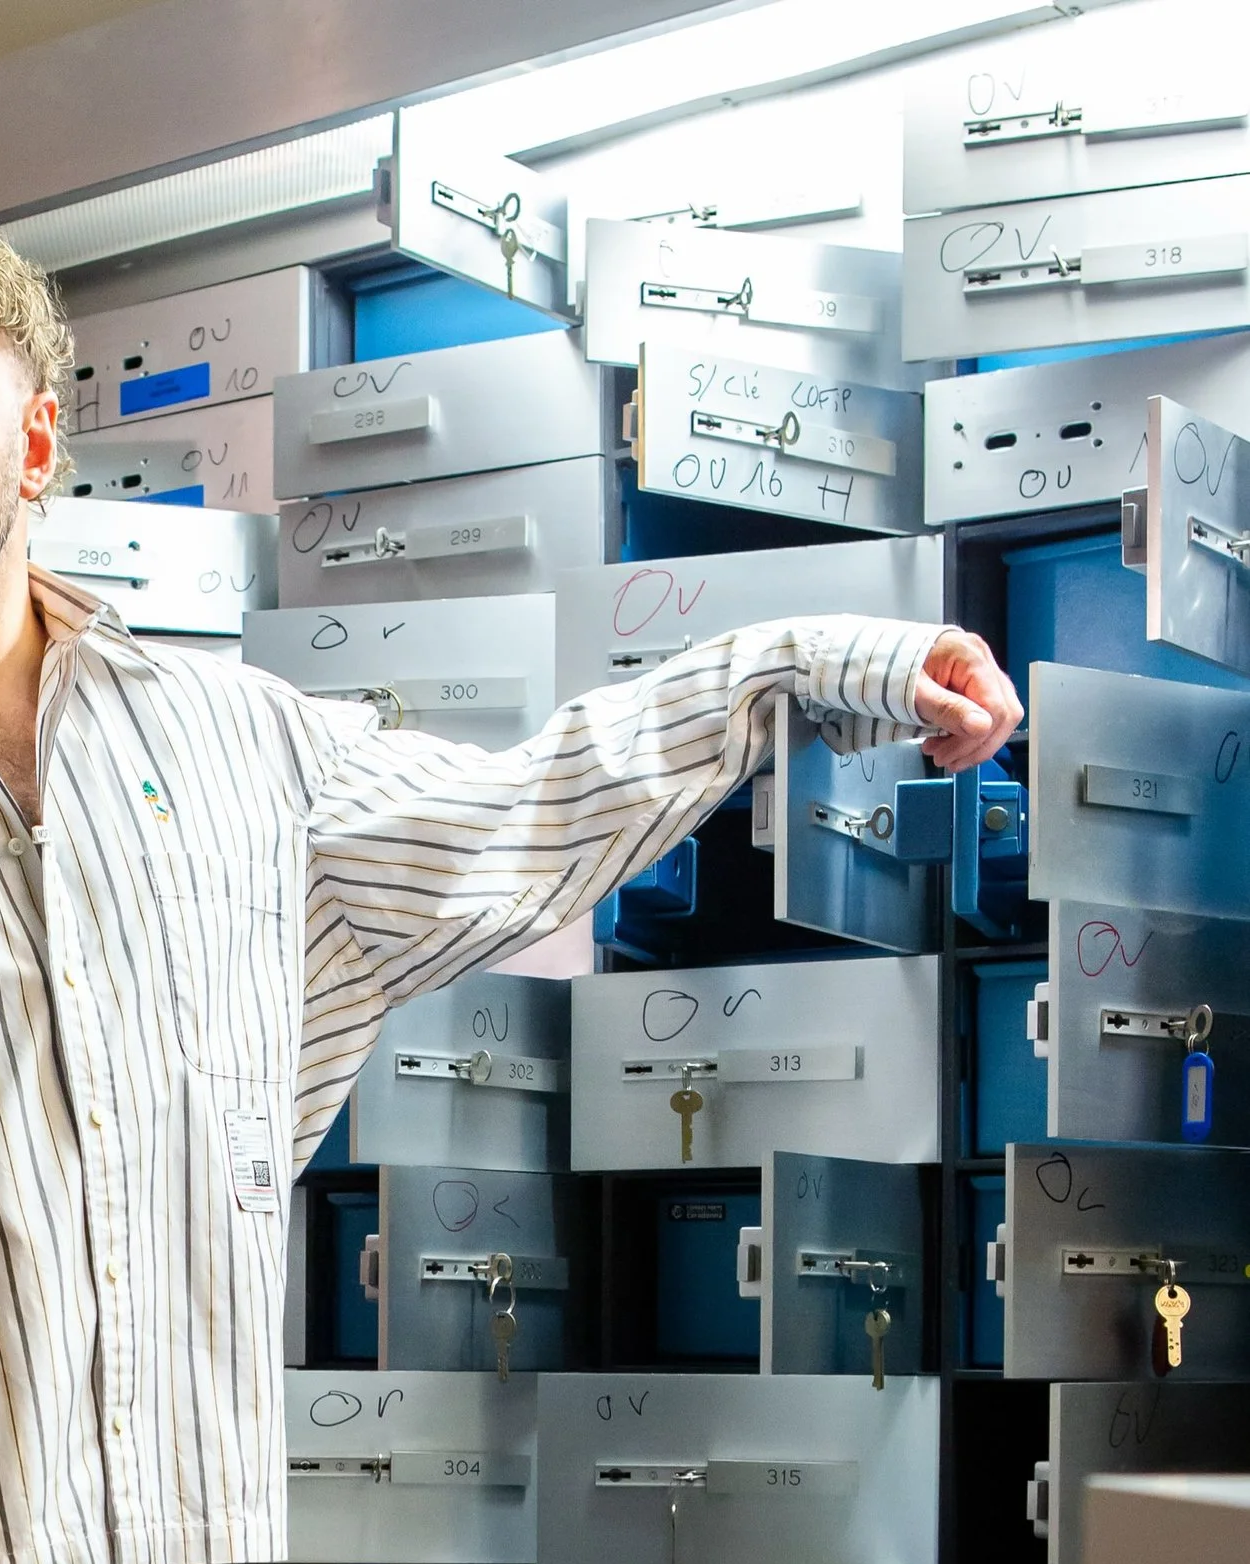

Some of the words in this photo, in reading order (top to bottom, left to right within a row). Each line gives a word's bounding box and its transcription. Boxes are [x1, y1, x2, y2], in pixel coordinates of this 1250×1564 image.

[1144, 247, 1183, 267] 318
[224, 366, 259, 391] 10
[353, 410, 386, 428] 298
[827, 436, 856, 457] 310
[740, 461, 784, 499] 16
[817, 474, 855, 522] H
[450, 528, 482, 546] 299
[78, 549, 112, 566] 290
[440, 684, 479, 701] 300
[1132, 778, 1159, 798] 321
[508, 1062, 535, 1081] 302
[769, 1055, 802, 1072] 313
[1207, 1254, 1239, 1272] 323
[443, 1460, 482, 1477] 304
[766, 1469, 802, 1487] 315
